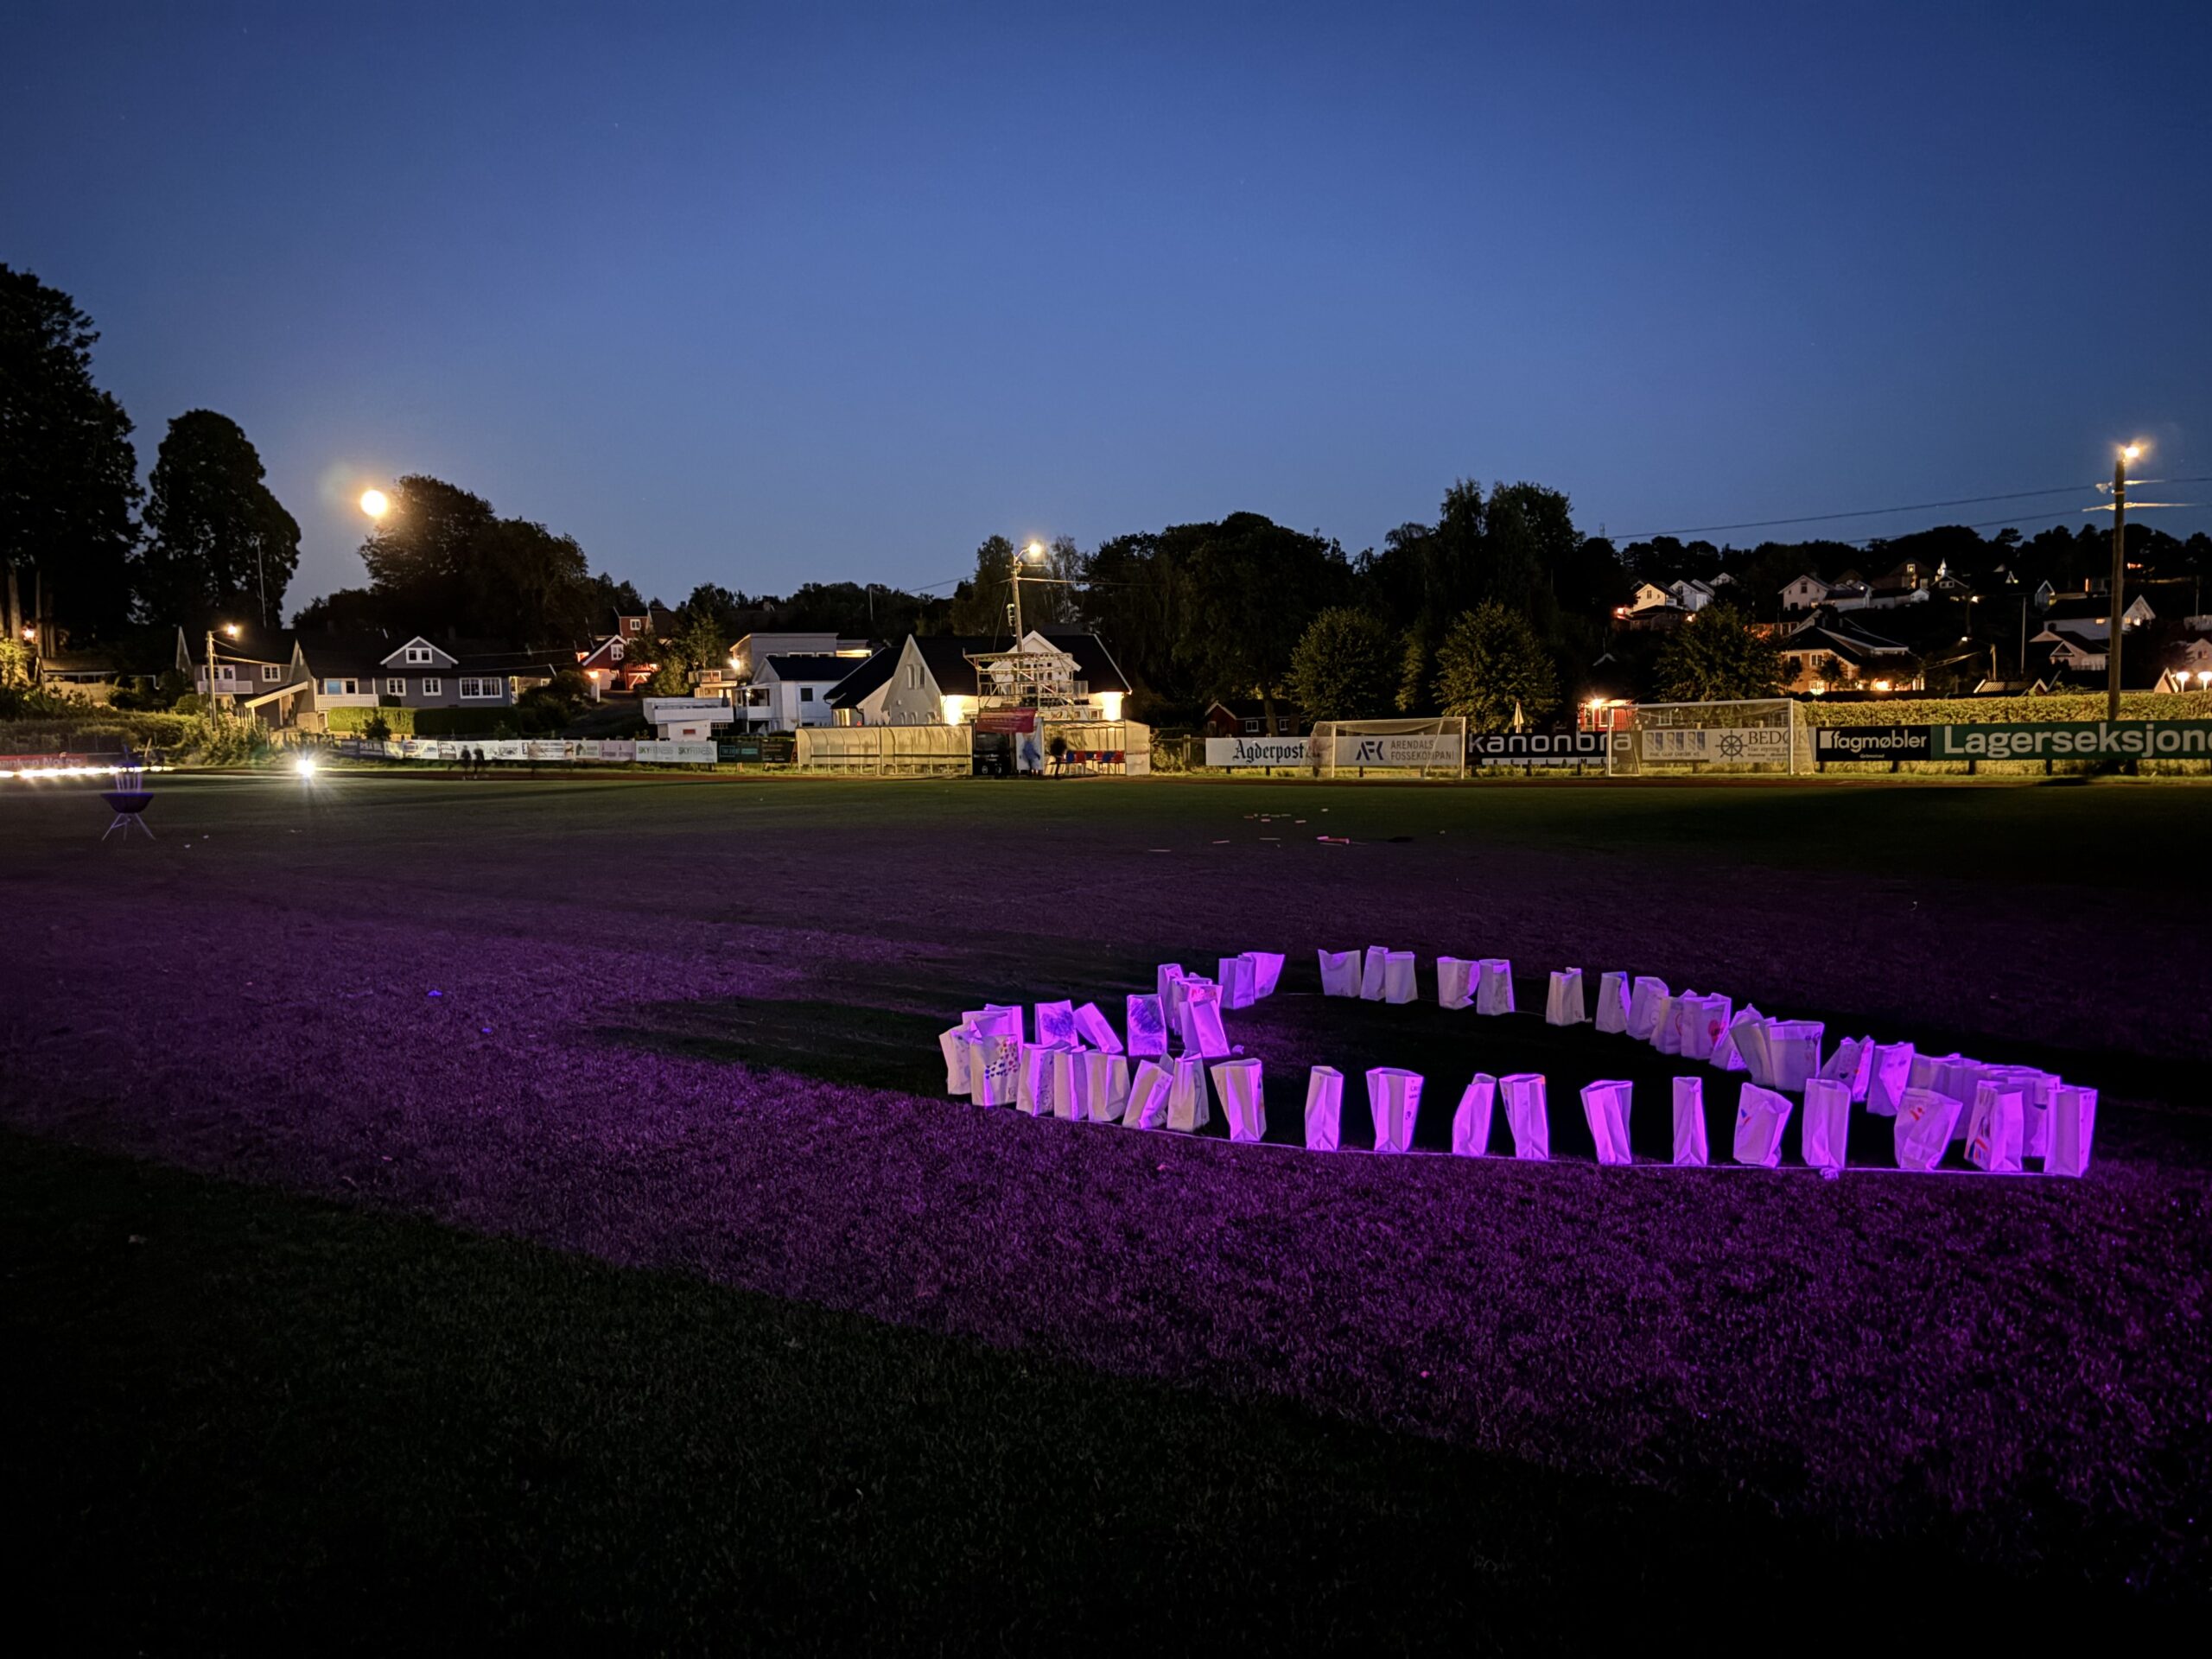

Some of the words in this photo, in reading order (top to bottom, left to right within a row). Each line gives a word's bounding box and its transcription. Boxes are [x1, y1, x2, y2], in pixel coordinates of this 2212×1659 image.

[1232, 740, 1304, 763] Agderpost
[1390, 741, 1434, 749] ARENDALS
[1470, 730, 1631, 753] kanonbra
[1833, 729, 1927, 753] fagmøbler
[1944, 722, 2212, 758] Lagerseksjon
[1493, 758, 1605, 766] REKLAME
